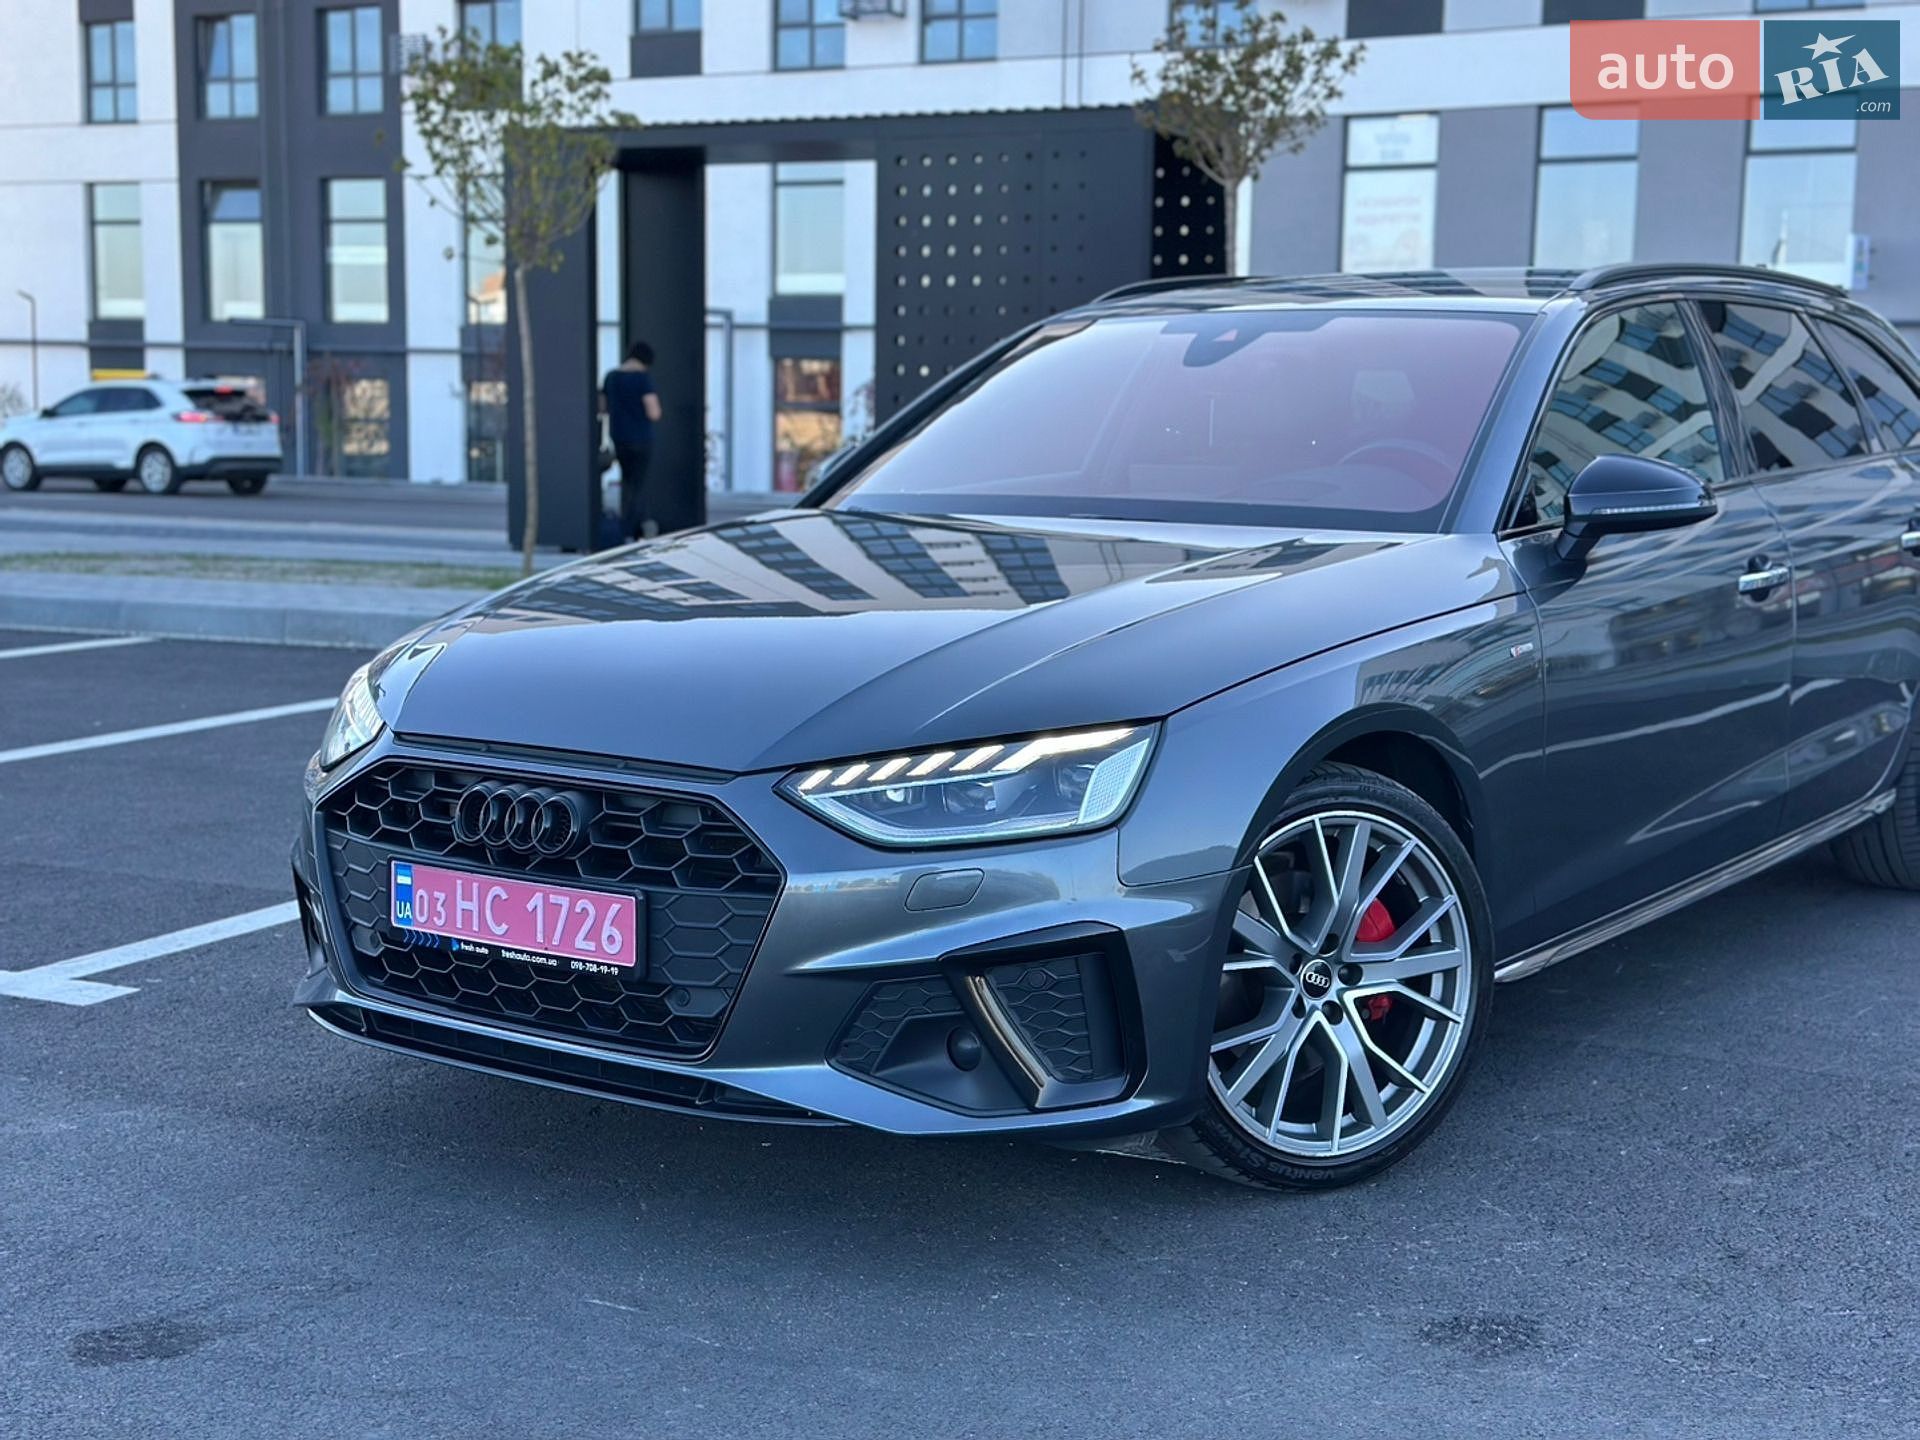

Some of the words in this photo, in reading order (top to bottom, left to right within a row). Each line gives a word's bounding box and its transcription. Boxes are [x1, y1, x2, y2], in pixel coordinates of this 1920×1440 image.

[397, 901, 412, 919] UA
[415, 888, 447, 927] 03
[455, 879, 509, 935] HC
[526, 891, 623, 955] 1726
[501, 949, 558, 967] freshauto.com.ua
